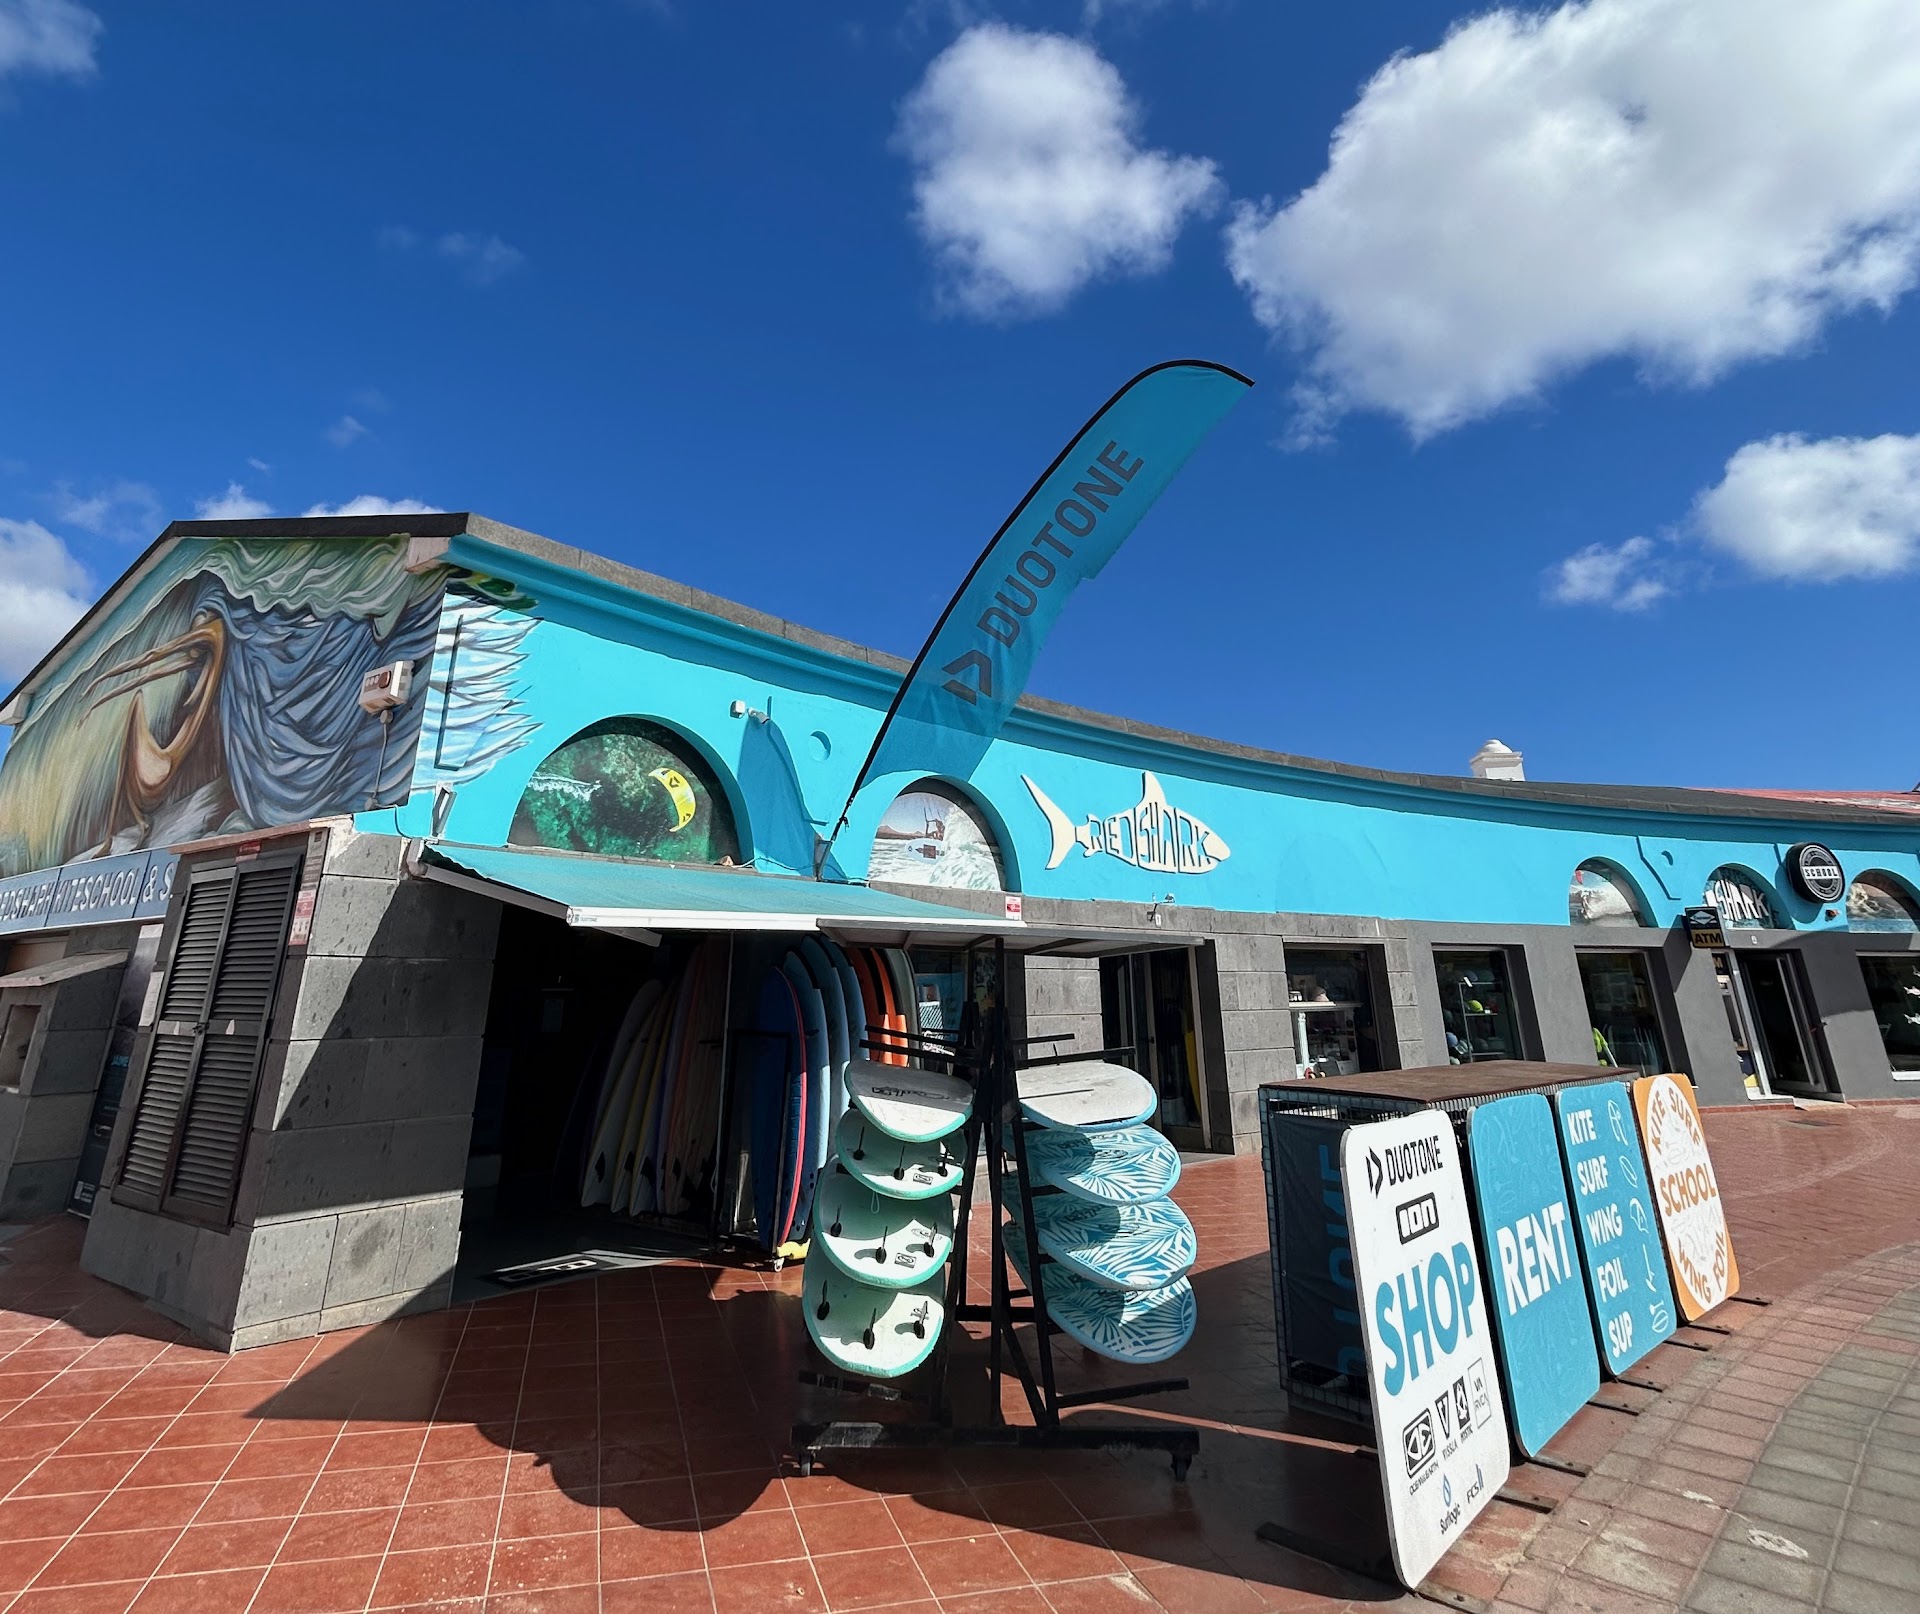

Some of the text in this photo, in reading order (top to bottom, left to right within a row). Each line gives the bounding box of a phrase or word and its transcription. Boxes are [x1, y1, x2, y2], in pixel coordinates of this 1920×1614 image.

[977, 440, 1145, 649] DUOTONE
[1084, 800, 1212, 869] REDSHARK
[54, 867, 141, 914] KITESCHOOL
[142, 865, 158, 903] &
[1804, 867, 1838, 877] SCHOOL
[1694, 932, 1722, 945] ATM
[1567, 1109, 1597, 1146] KITE
[1650, 1086, 1700, 1154] KITE SURF
[1385, 1135, 1444, 1186] DUOTONE
[1577, 1155, 1609, 1196] SURF
[1659, 1163, 1716, 1217] SCHOOL
[1586, 1203, 1623, 1247] WING
[1496, 1201, 1572, 1316] RENT
[1597, 1257, 1629, 1303] FOIL
[1677, 1230, 1727, 1304] WING FOIL
[1375, 1241, 1475, 1397] SHOP
[1608, 1311, 1633, 1358] SUP
